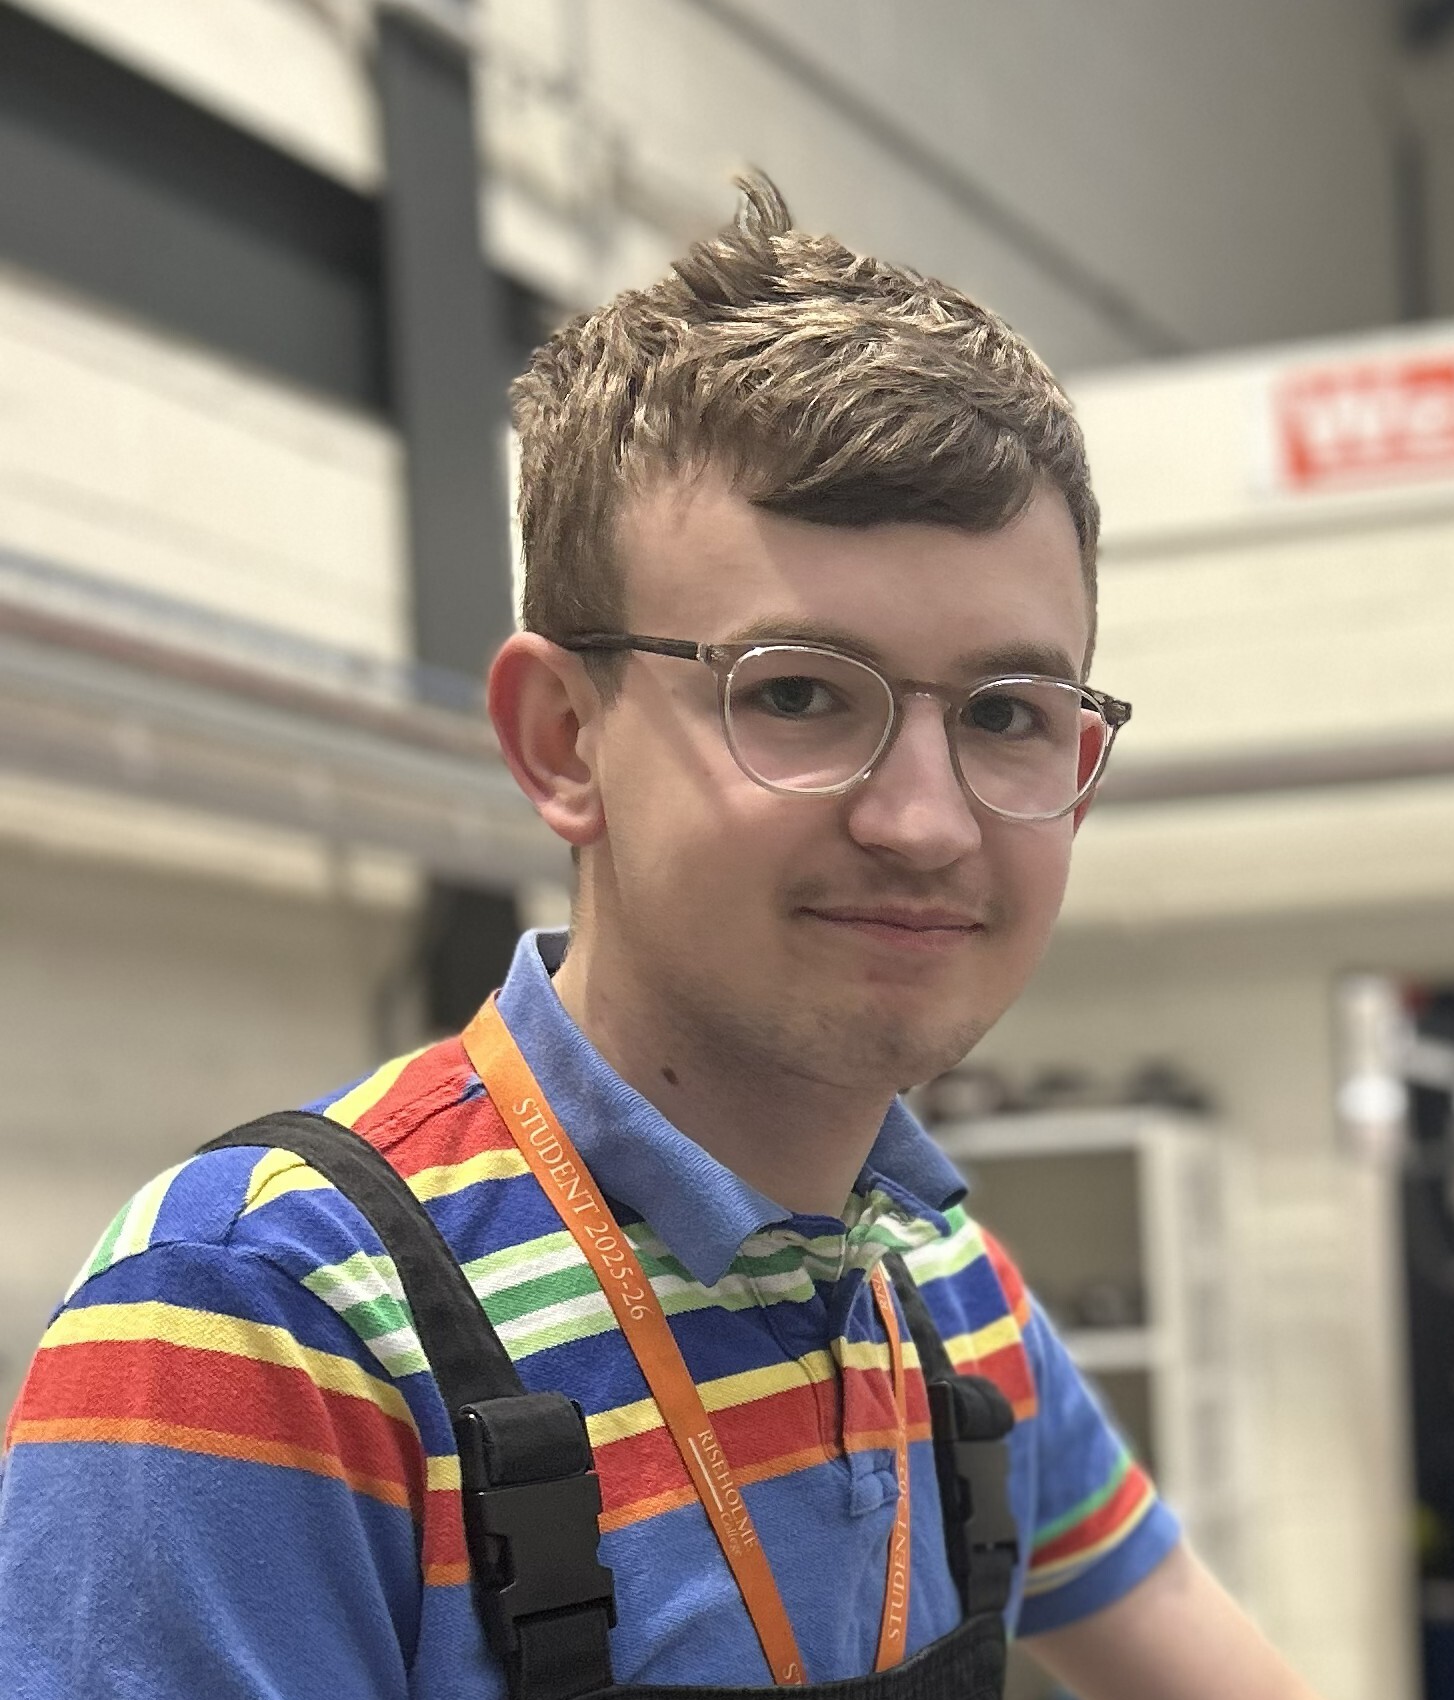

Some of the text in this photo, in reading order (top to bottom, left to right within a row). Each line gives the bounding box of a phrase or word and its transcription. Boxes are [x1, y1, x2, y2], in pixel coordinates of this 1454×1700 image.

[512, 1097, 654, 1321] STUDENT 2025-26
[698, 1429, 758, 1550] RISEHOLME
[887, 1518, 907, 1641] STUDENT
